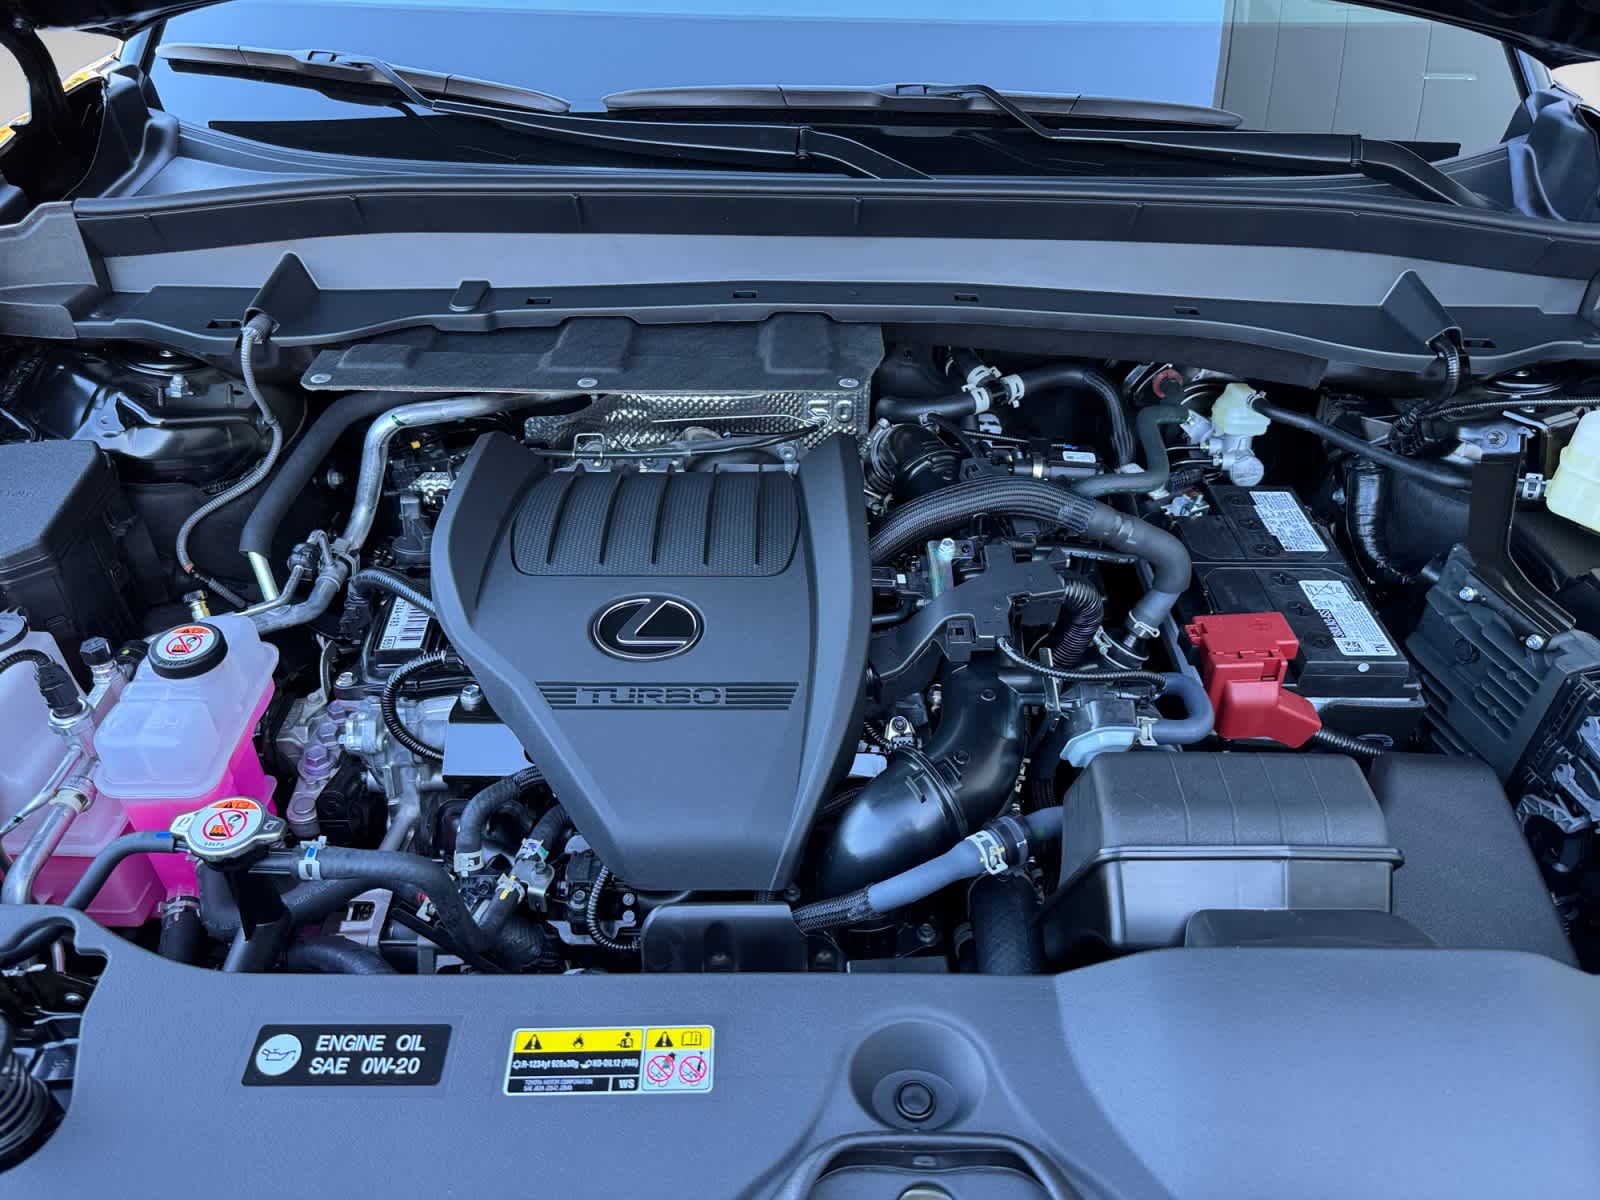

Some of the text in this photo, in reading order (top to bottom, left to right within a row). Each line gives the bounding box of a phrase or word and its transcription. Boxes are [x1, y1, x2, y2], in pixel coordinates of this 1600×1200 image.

[580, 687, 721, 705] TURBO
[315, 1034, 426, 1052] ENGINE OIL
[308, 1057, 421, 1075] SAE 0W-20
[619, 1079, 635, 1089] WS
